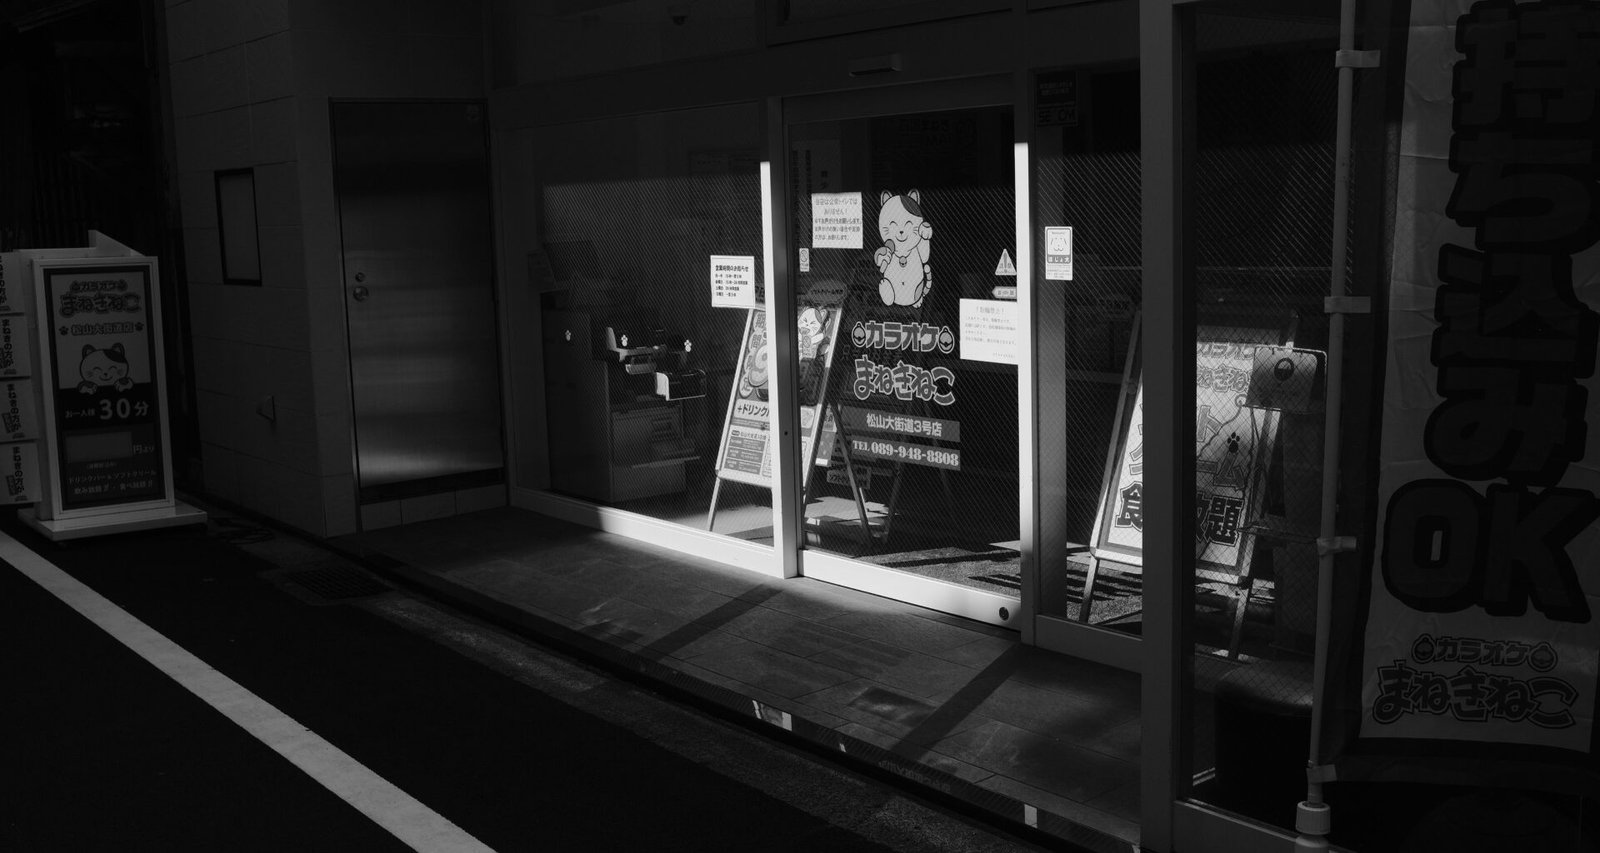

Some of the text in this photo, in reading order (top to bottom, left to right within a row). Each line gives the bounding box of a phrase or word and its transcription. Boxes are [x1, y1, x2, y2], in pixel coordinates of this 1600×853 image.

[1423, 0, 1600, 486] 持ち込み
[59, 291, 142, 317] まねきねこ
[865, 320, 940, 352] カラオケ
[854, 354, 956, 406] まねきねこ
[866, 413, 943, 437] 松山大街道3号店
[852, 440, 959, 467] TEL 089-948-8808
[1382, 478, 1599, 623] OK
[1436, 637, 1531, 666] カラオケ
[1373, 659, 1579, 728] まねきねこ
